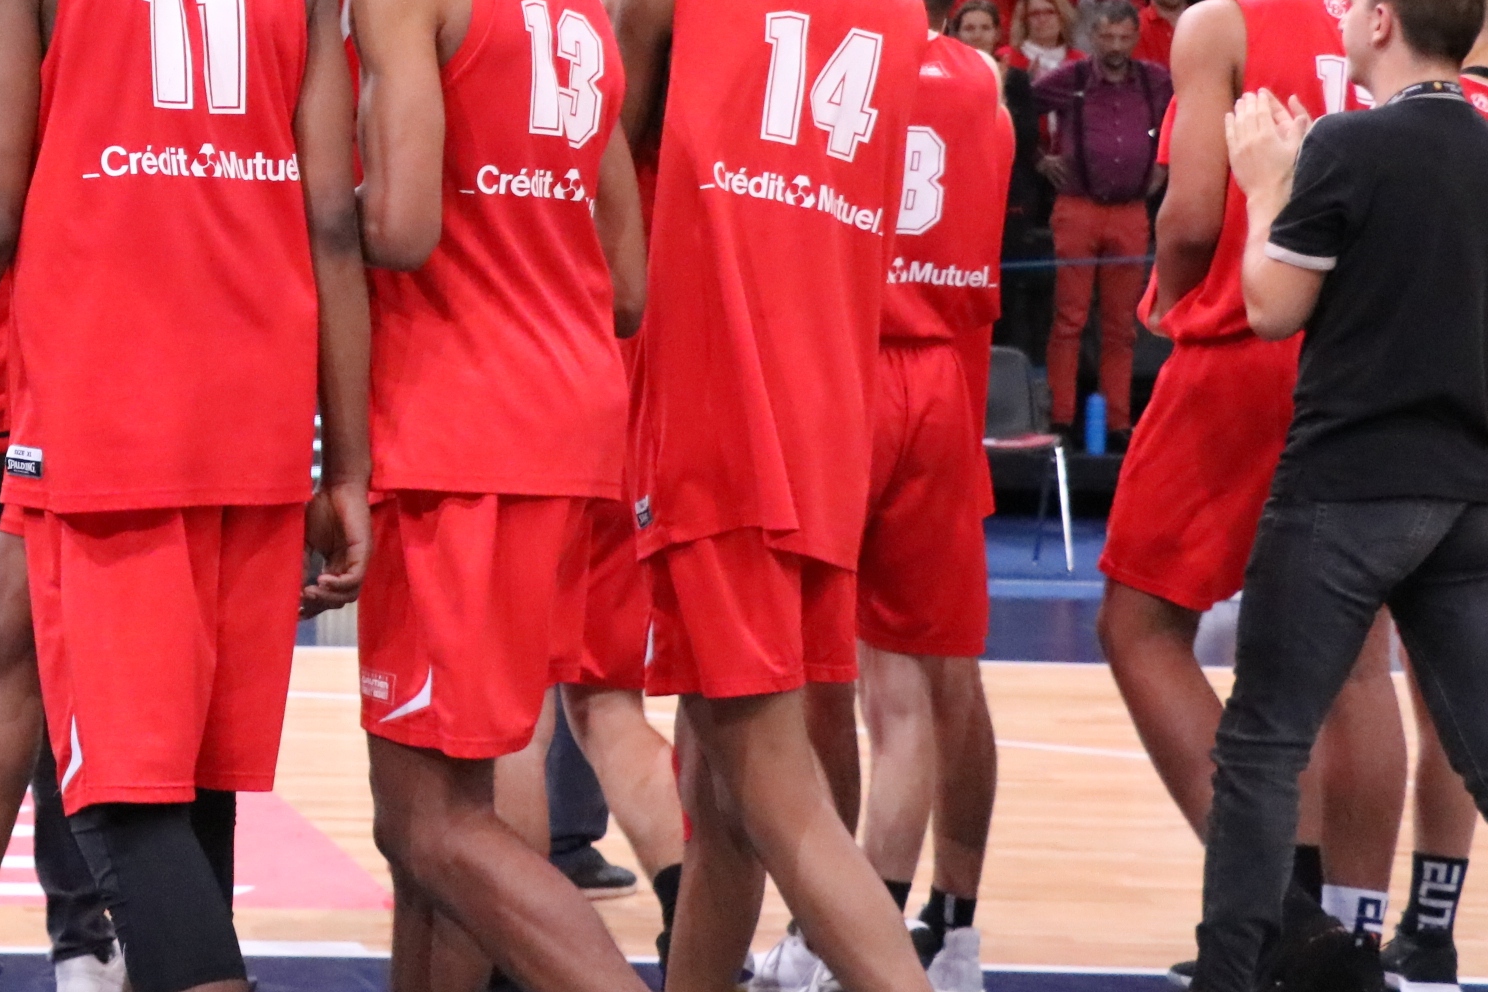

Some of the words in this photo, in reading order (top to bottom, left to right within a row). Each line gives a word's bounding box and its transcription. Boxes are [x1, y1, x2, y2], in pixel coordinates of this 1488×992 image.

[760, 11, 882, 162] 14
[219, 151, 300, 181] Mutue
[7, 458, 37, 474] SPALDING
